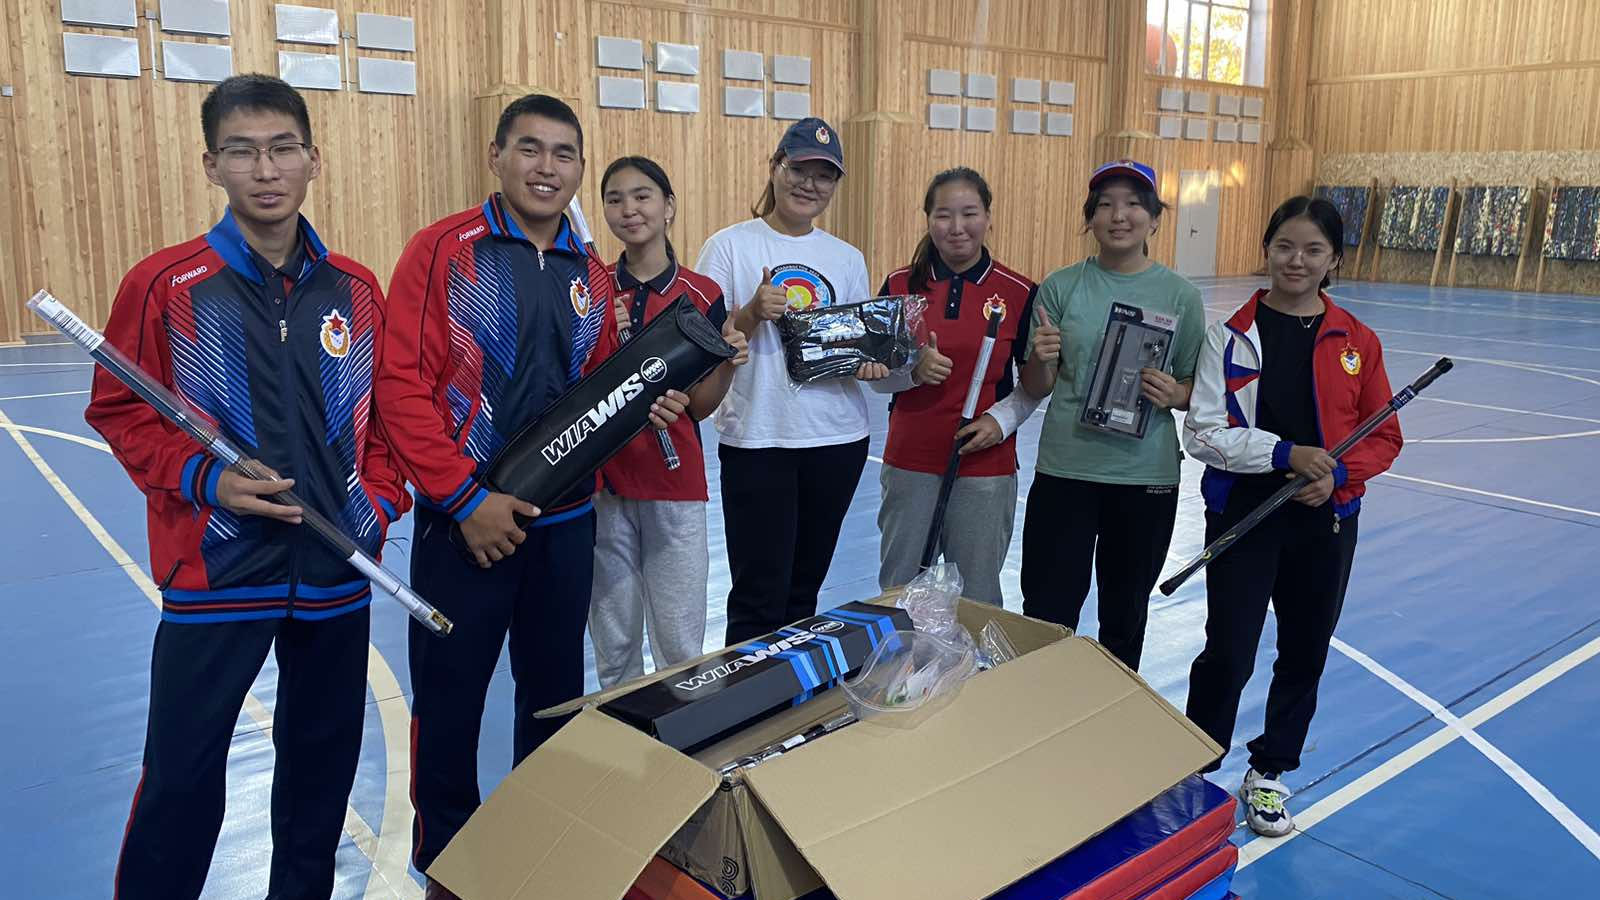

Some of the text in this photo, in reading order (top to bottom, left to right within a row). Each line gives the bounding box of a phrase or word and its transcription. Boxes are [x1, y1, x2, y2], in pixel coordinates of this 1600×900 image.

[459, 225, 485, 242] FORWARD
[172, 265, 208, 287] FORWARD
[541, 372, 645, 466] WIAWIS
[675, 630, 817, 691] WIAWIS
